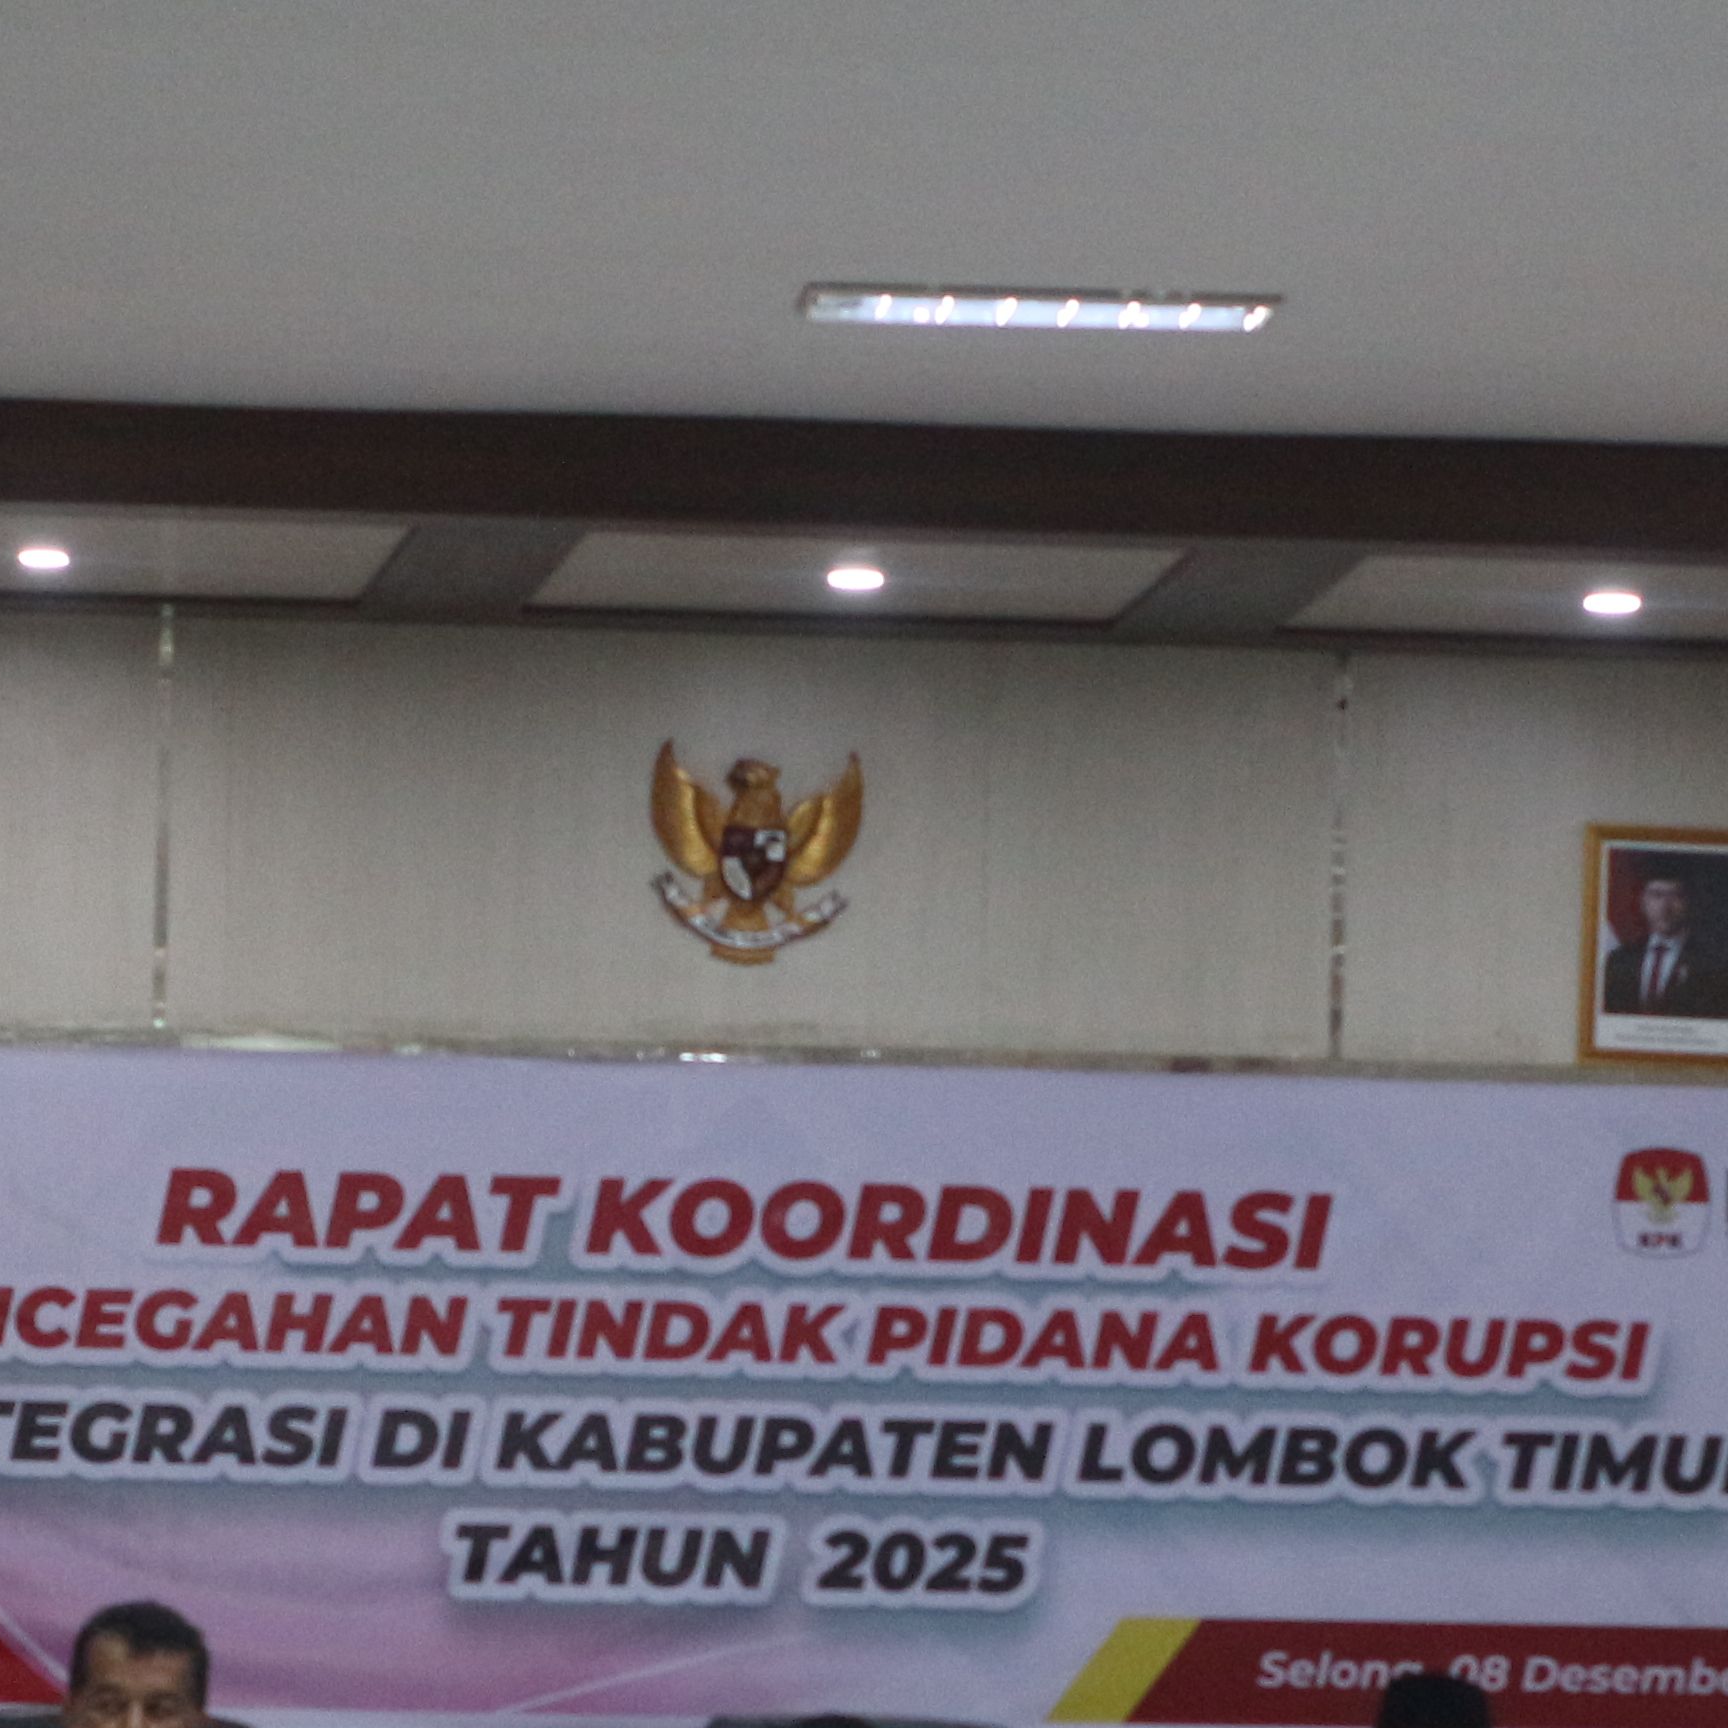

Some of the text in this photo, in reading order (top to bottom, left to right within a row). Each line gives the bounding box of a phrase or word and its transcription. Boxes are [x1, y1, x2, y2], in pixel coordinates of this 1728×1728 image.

[156, 1168, 1334, 1270] RAPAT KOORDINASI
[496, 1297, 846, 1364] TINDAK
[866, 1305, 1220, 1372] PIDANA
[1247, 1313, 1651, 1381] KORUPSI
[371, 1409, 472, 1469] DI
[495, 1411, 1055, 1481] KABUPATEN
[1077, 1423, 1477, 1489] LOMBOK
[455, 1524, 1030, 1594] TAHUN 2025
